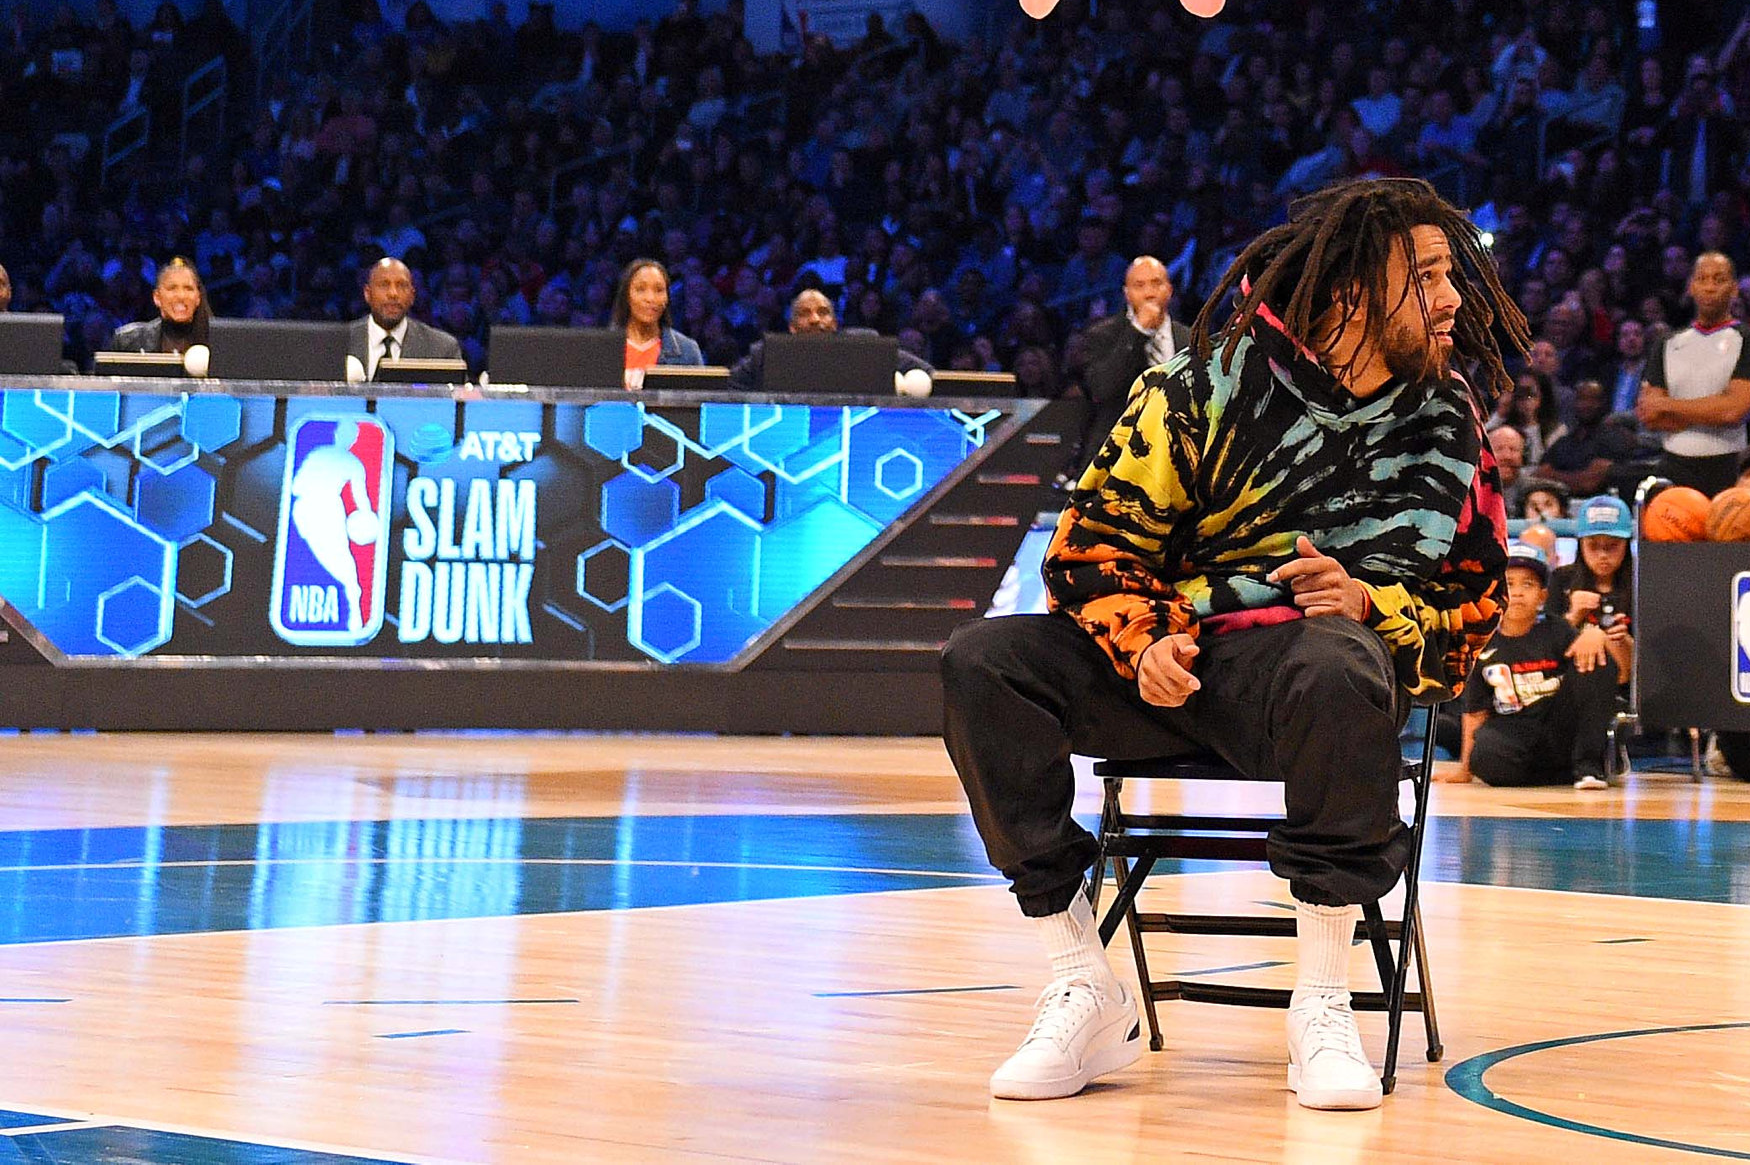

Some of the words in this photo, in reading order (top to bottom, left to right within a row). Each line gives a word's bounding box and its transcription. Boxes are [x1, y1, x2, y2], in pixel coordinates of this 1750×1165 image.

[459, 431, 542, 462] AT&T
[403, 476, 537, 561] SLAM
[288, 584, 339, 623] NBA
[398, 560, 535, 644] DUNK
